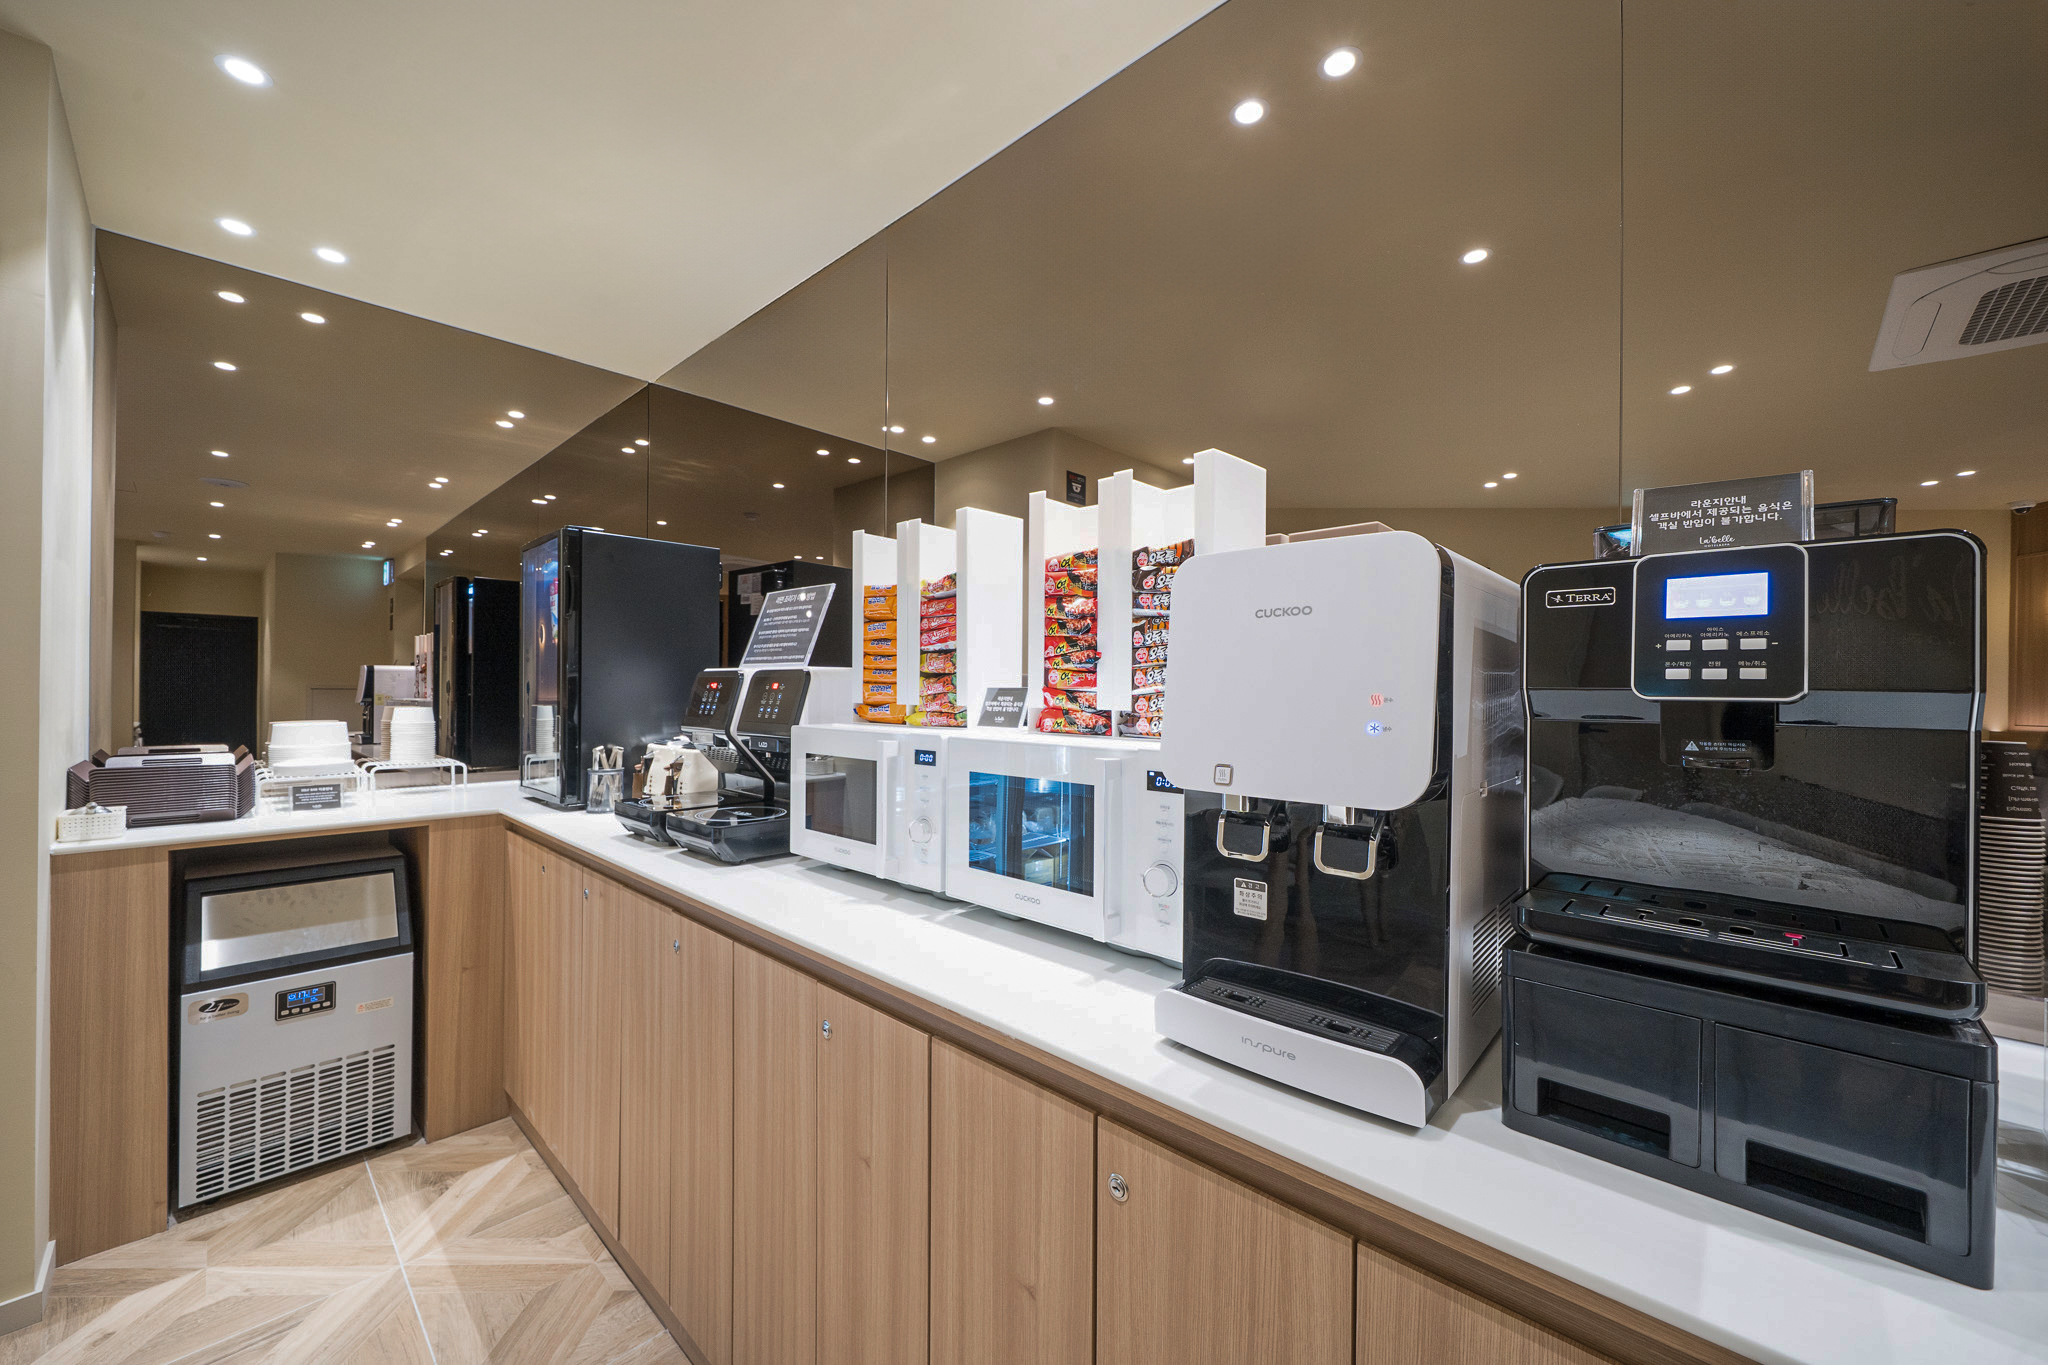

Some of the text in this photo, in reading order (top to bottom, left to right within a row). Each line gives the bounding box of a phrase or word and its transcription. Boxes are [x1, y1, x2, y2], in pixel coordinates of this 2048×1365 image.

[1690, 495, 1747, 508] 라운지안내
[1649, 501, 1793, 522] 셀프바에서 제공되는 음식은
[1657, 521, 1678, 530] 객실
[1682, 518, 1715, 529] 반입이
[1255, 605, 1313, 619] CUCKOO
[919, 753, 934, 763] 0:00
